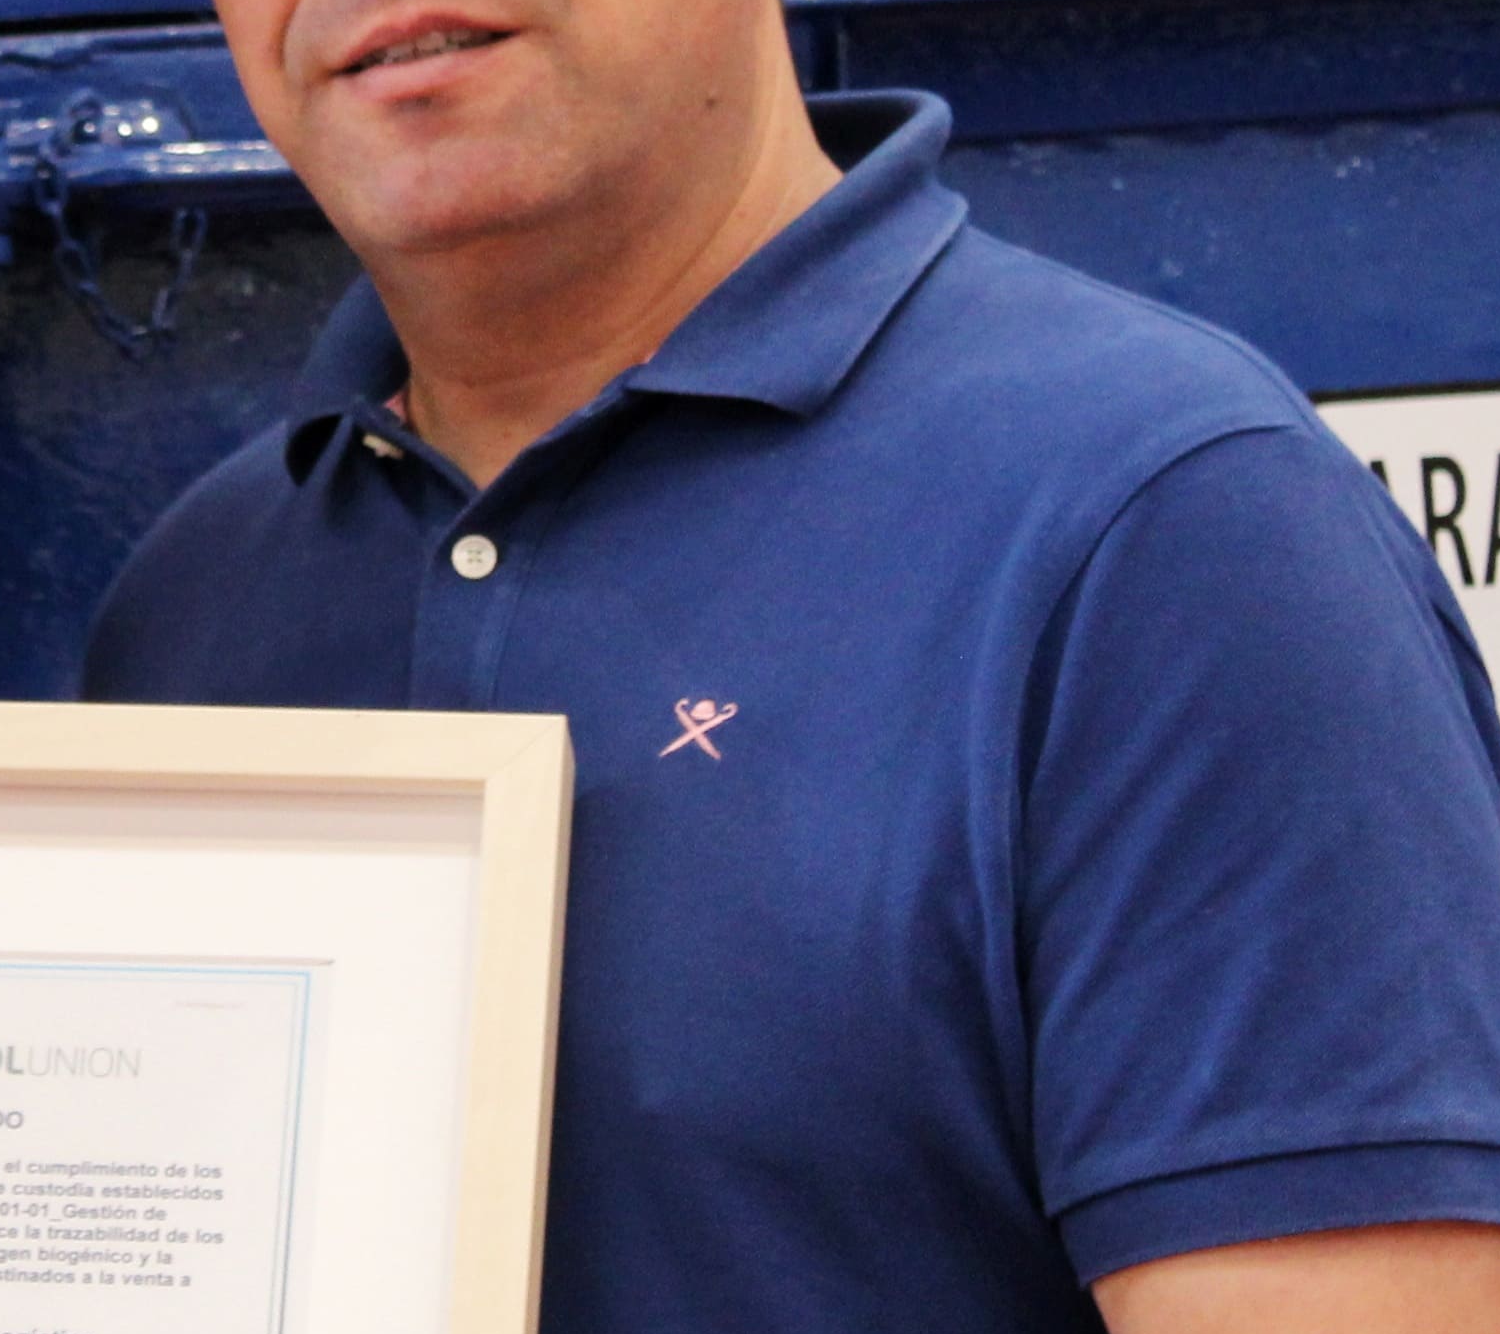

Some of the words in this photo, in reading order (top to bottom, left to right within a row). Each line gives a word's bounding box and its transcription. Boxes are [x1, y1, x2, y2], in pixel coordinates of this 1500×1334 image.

[2, 1158, 22, 1174] el
[25, 1159, 161, 1181] cumplimiento
[163, 1162, 189, 1179] de
[193, 1163, 223, 1180] los
[100, 1182, 225, 1202] establecidos
[142, 1205, 169, 1222] de
[23, 1224, 43, 1240] la
[45, 1224, 161, 1243] trazabilidad
[164, 1227, 191, 1244] de
[194, 1228, 225, 1245] los
[36, 1245, 135, 1268] biogénico
[138, 1252, 152, 1268] y
[155, 1249, 175, 1265] la
[81, 1272, 94, 1285] a
[98, 1269, 117, 1285] la
[120, 1271, 175, 1287] venta
[179, 1275, 192, 1288] a
